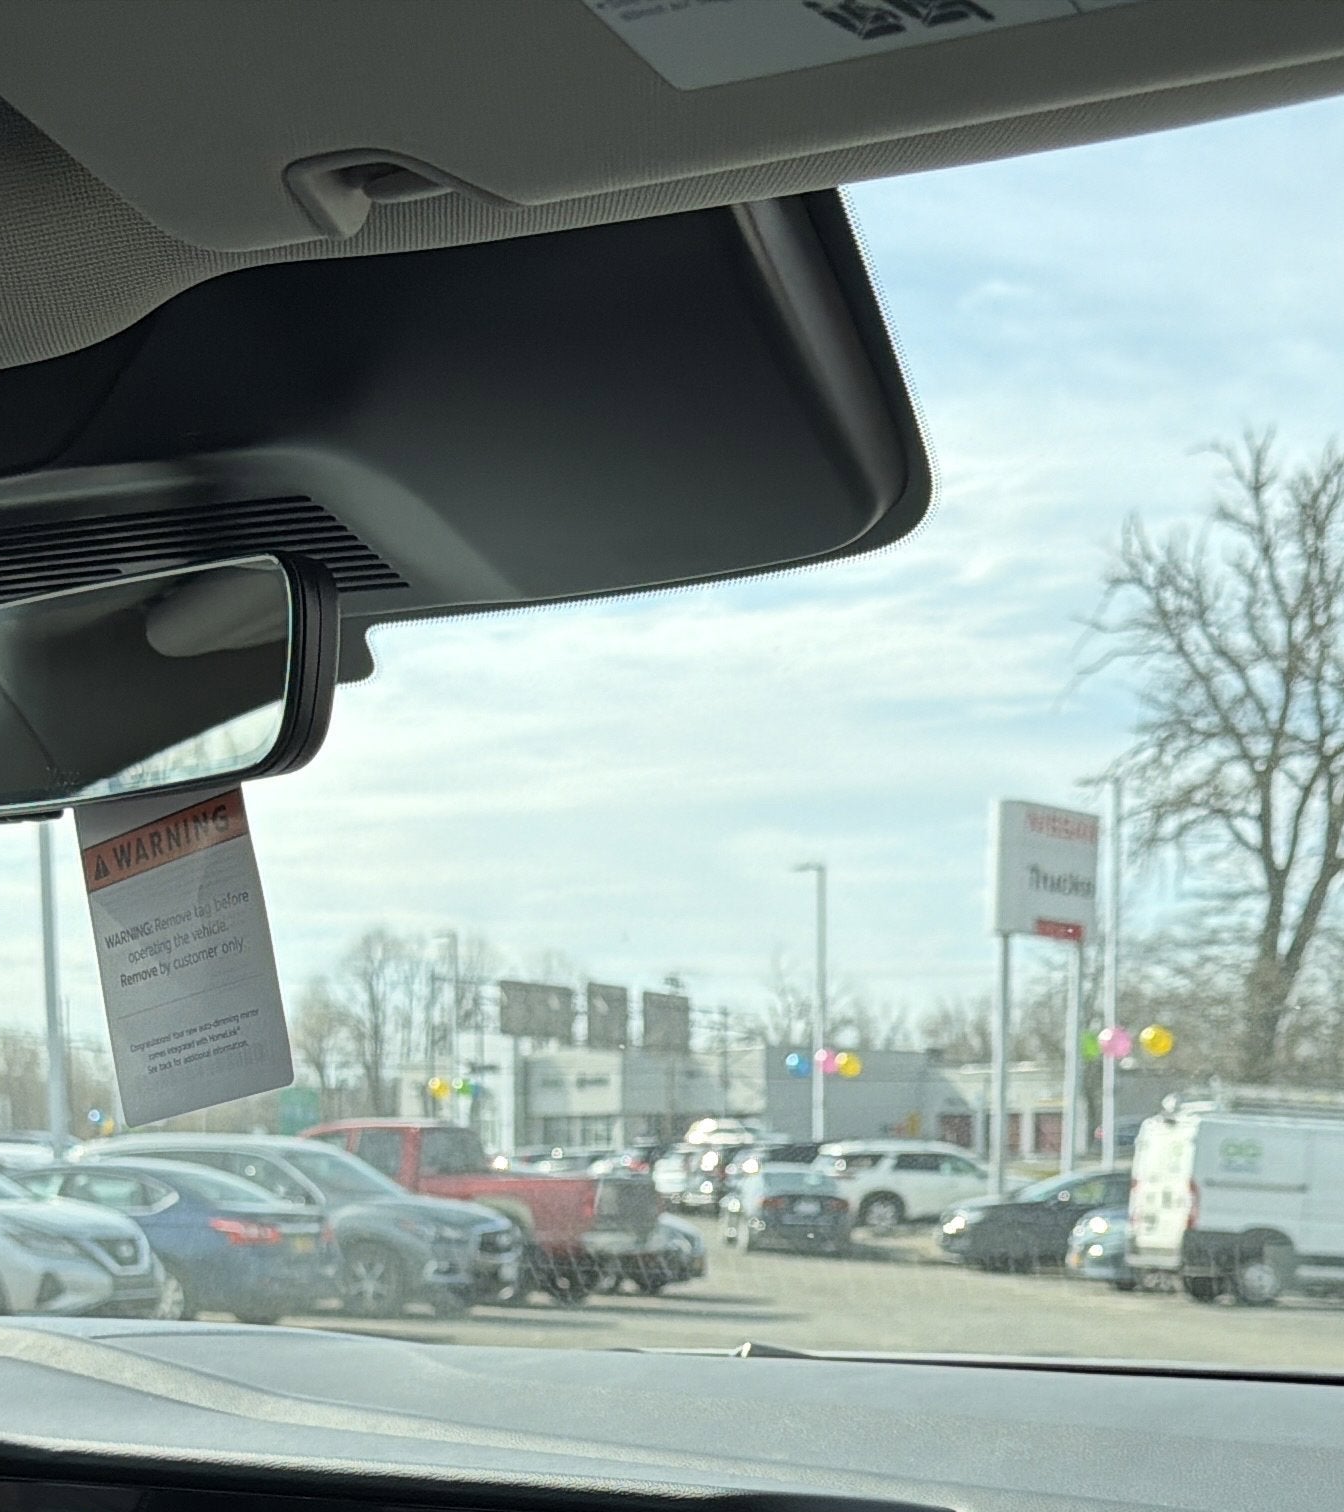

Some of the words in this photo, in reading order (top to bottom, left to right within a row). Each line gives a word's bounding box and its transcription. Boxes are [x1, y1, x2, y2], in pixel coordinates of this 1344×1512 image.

[112, 804, 230, 869] WARNING
[104, 922, 154, 949] WARNING:
[155, 910, 192, 931] Remove
[194, 904, 212, 921] tag
[214, 890, 250, 914] before
[128, 938, 172, 964] operating
[174, 931, 190, 947] the
[192, 921, 229, 941] vehicle.
[120, 967, 158, 988] Remove
[159, 961, 171, 977] by
[174, 946, 218, 971] customer
[222, 936, 245, 956] only
